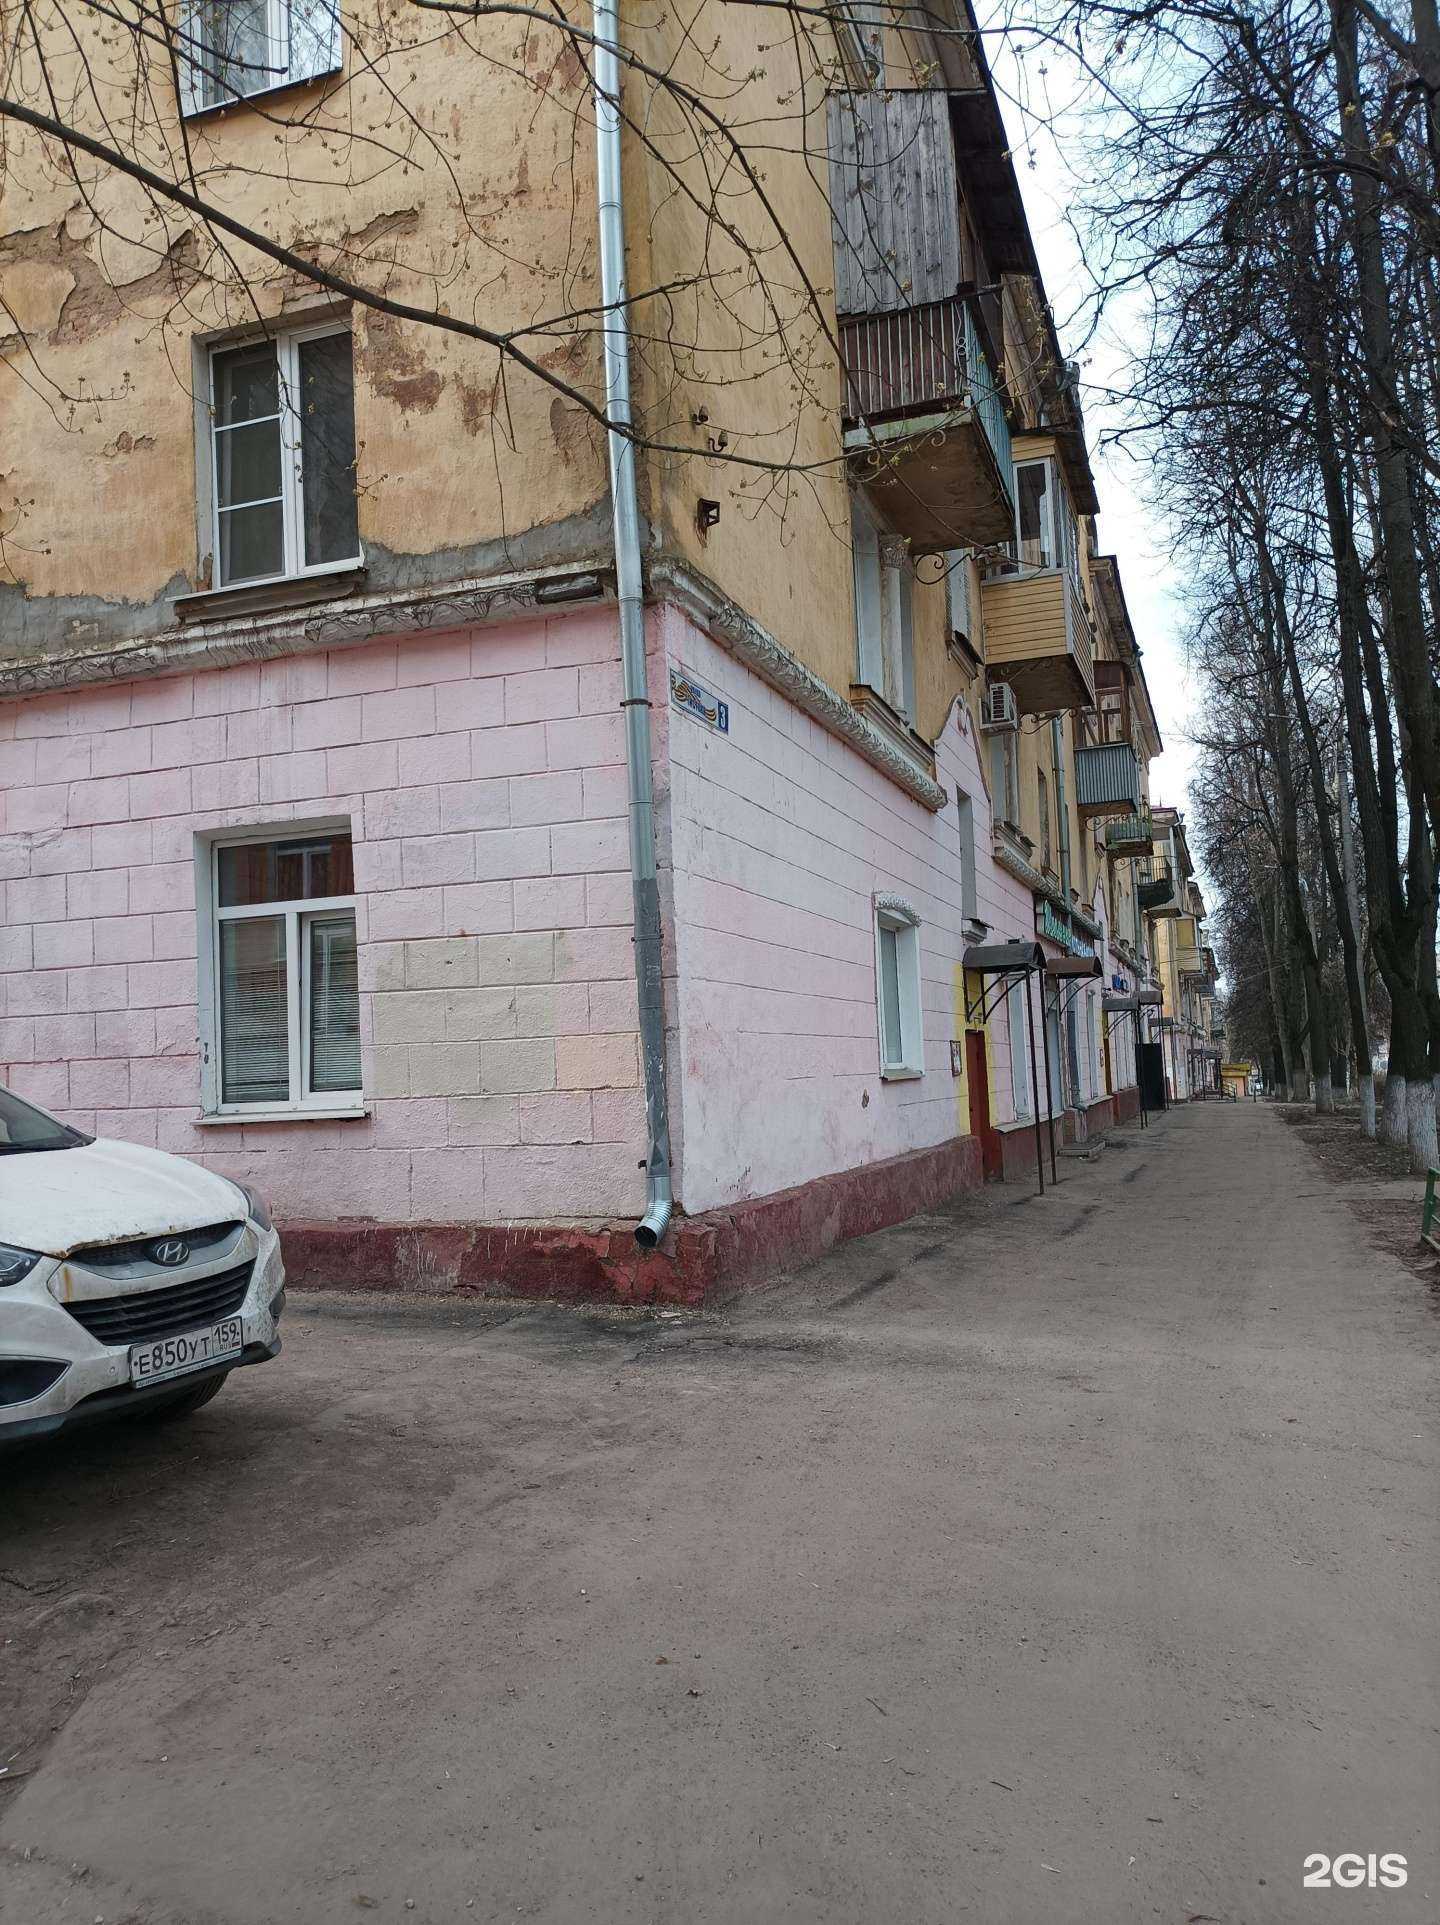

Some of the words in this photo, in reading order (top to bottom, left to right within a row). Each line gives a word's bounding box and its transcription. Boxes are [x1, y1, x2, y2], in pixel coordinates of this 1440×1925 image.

[720, 705, 726, 729] 3
[139, 1337, 210, 1375] Е850УТ
[214, 1322, 236, 1344] 159
